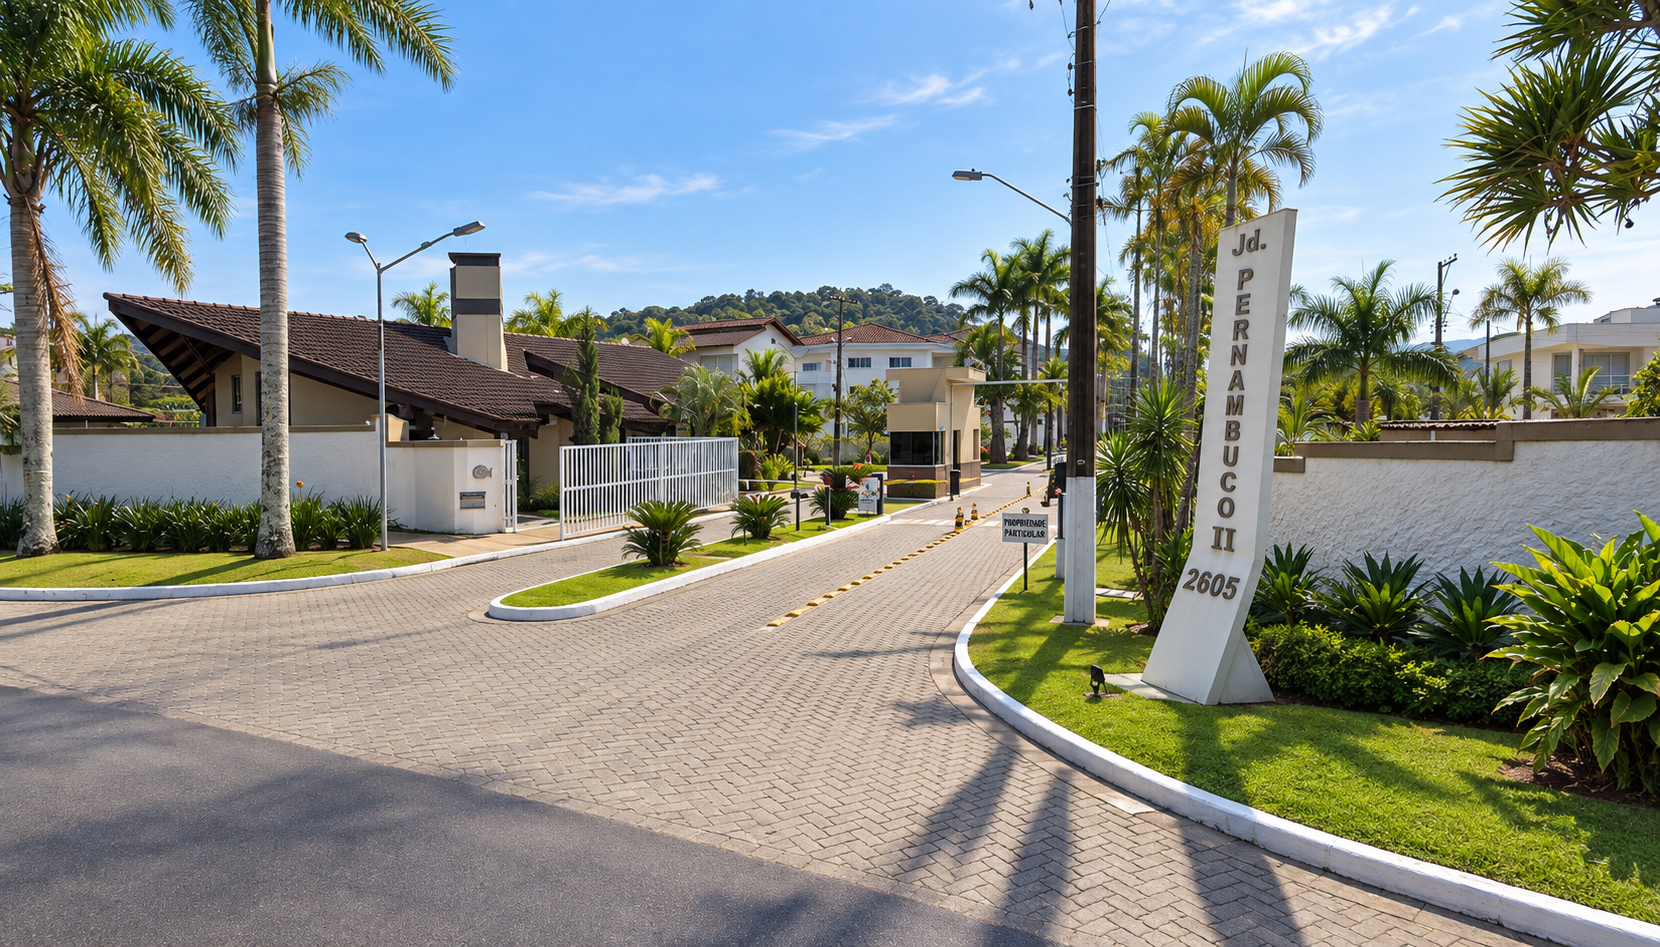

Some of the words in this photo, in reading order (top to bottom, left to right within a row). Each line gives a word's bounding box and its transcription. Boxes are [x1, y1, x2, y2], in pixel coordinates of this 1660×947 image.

[1231, 229, 1267, 256] Jd.
[1217, 268, 1254, 518] PERNAMBUCO
[1004, 529, 1045, 538] PARTICULAR
[1210, 526, 1236, 553] II
[1182, 568, 1240, 600] 2605
